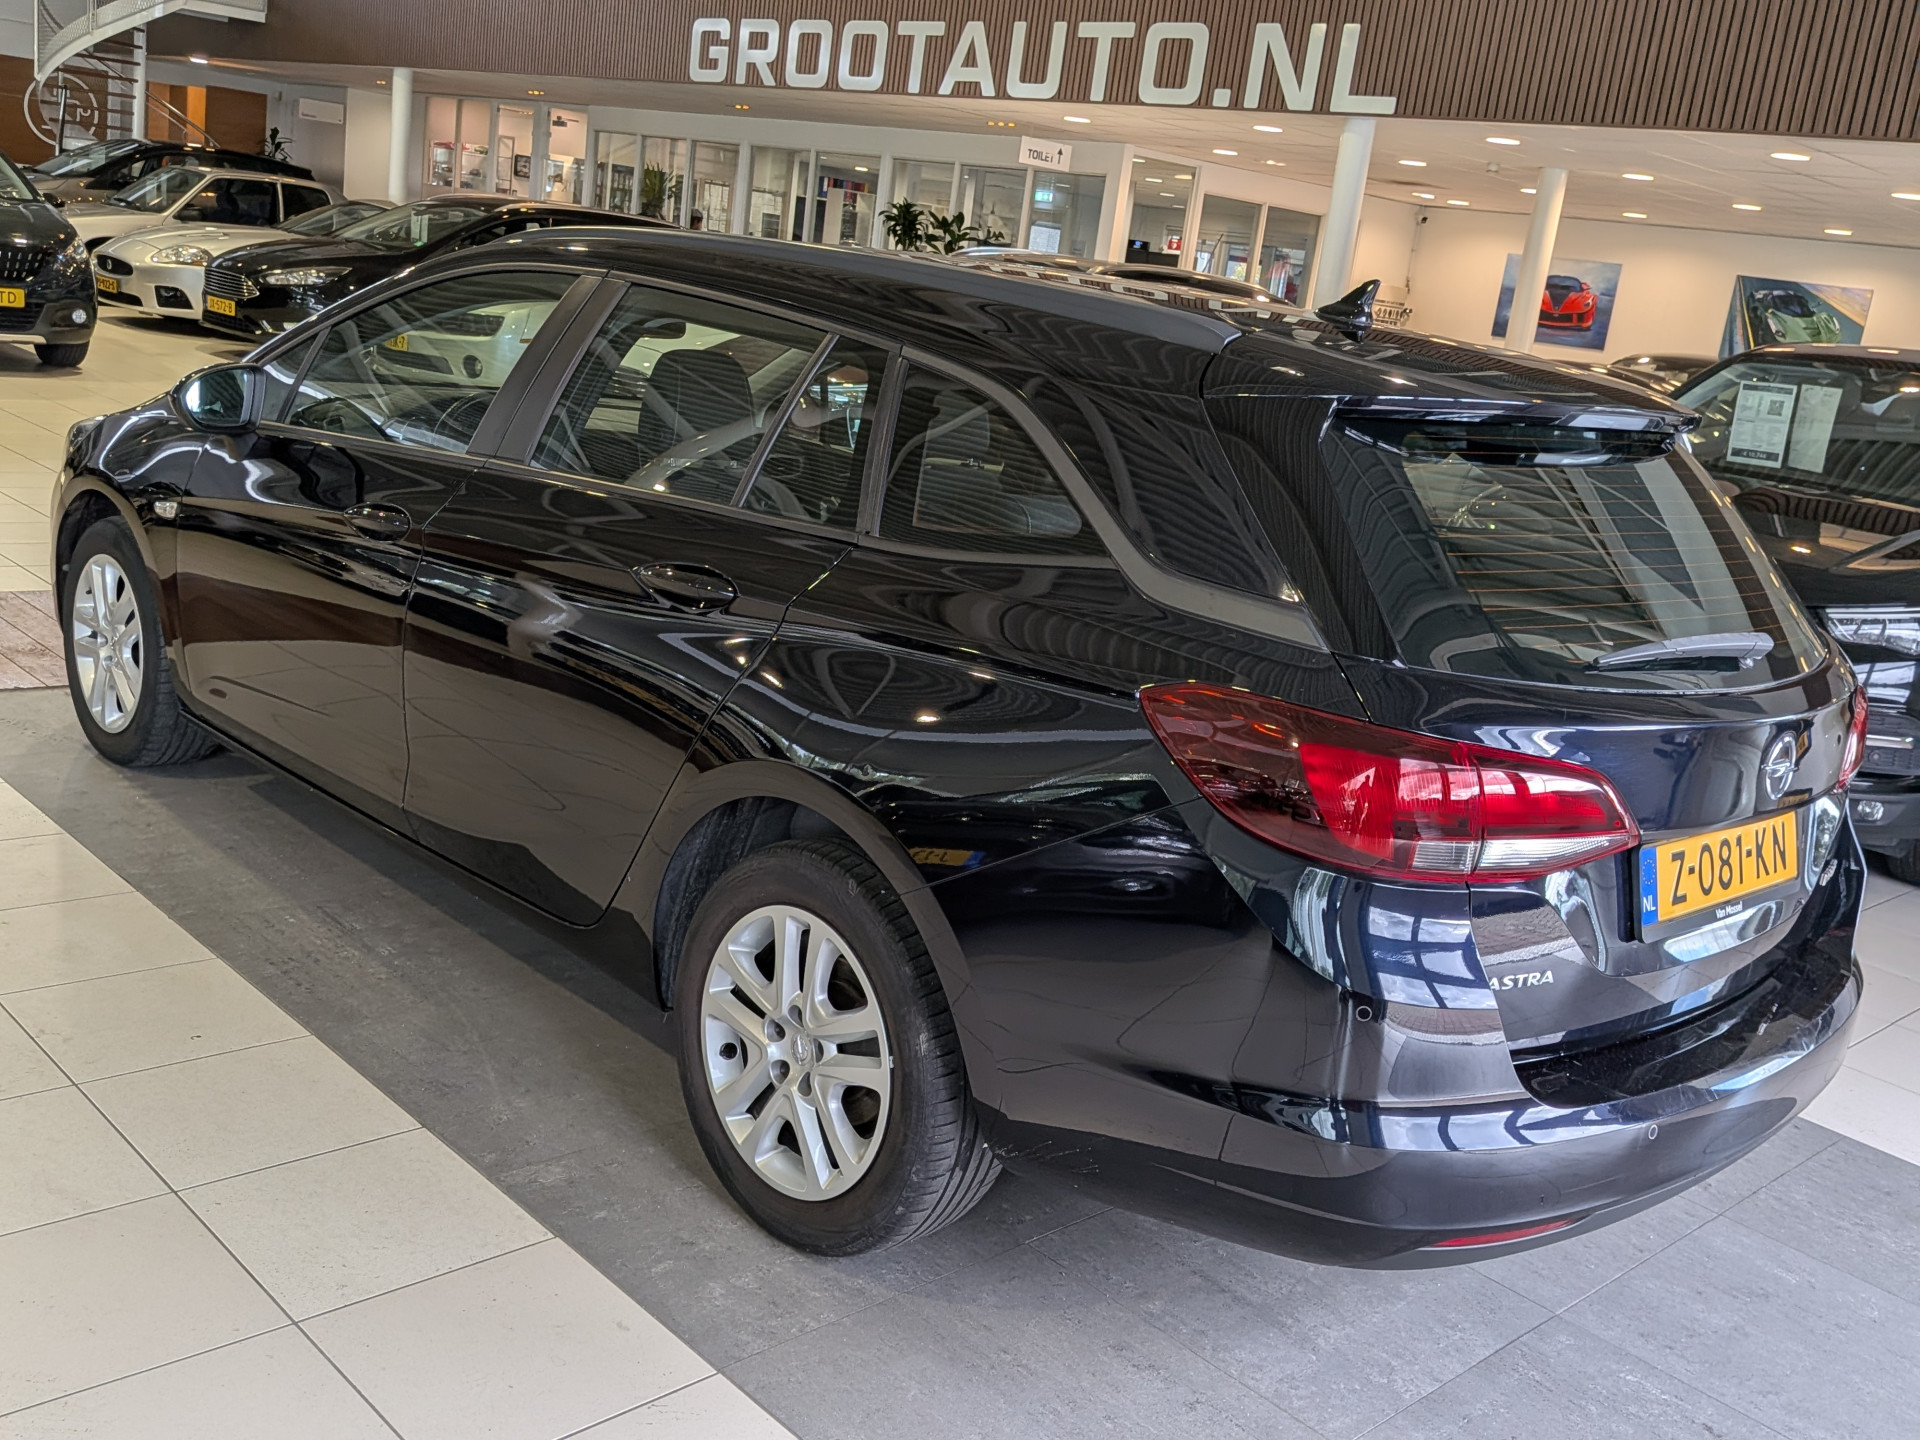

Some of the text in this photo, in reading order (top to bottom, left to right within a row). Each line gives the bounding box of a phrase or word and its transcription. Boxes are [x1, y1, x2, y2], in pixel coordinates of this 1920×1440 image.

[689, 17, 1397, 114] GROOTAUTO.NL
[1671, 821, 1787, 906] Z-081-KN
[1643, 894, 1656, 913] NL
[1489, 970, 1554, 991] ASTRA
